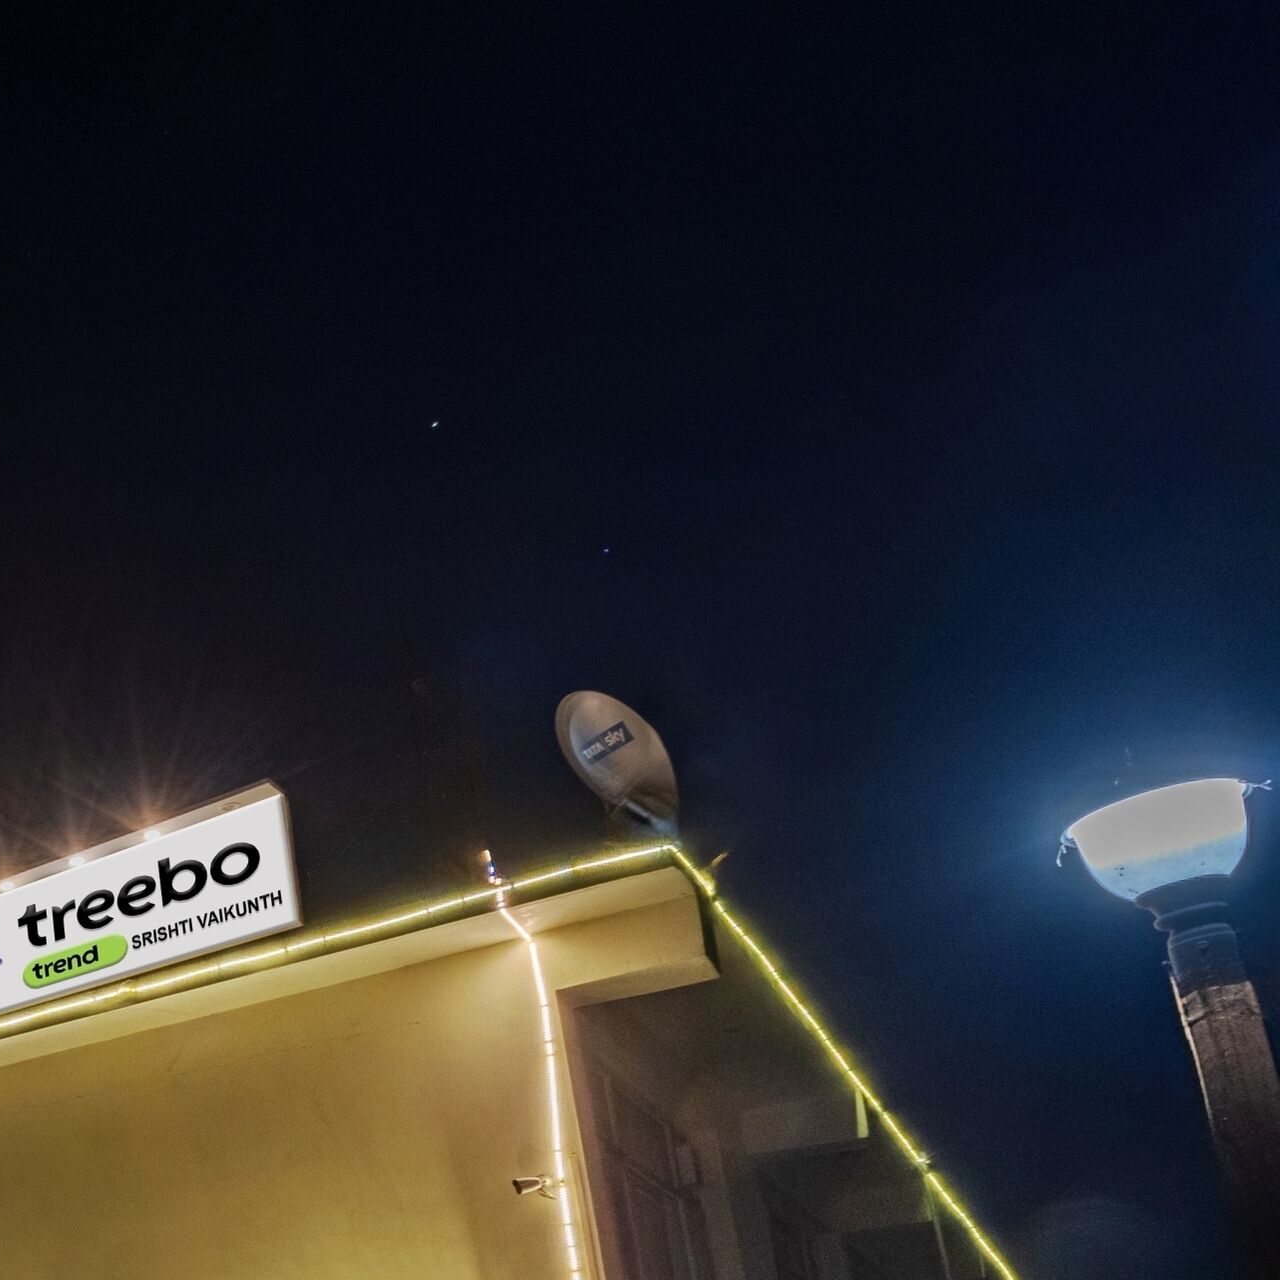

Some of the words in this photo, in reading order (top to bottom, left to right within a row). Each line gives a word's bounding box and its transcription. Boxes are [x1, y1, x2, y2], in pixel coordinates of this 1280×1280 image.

[582, 742, 603, 758] TATA
[604, 728, 625, 746] sky
[17, 842, 261, 947] treebo
[131, 919, 194, 950] SRISHTI
[196, 890, 282, 930] VAIKUNTH
[32, 945, 99, 980] trend
